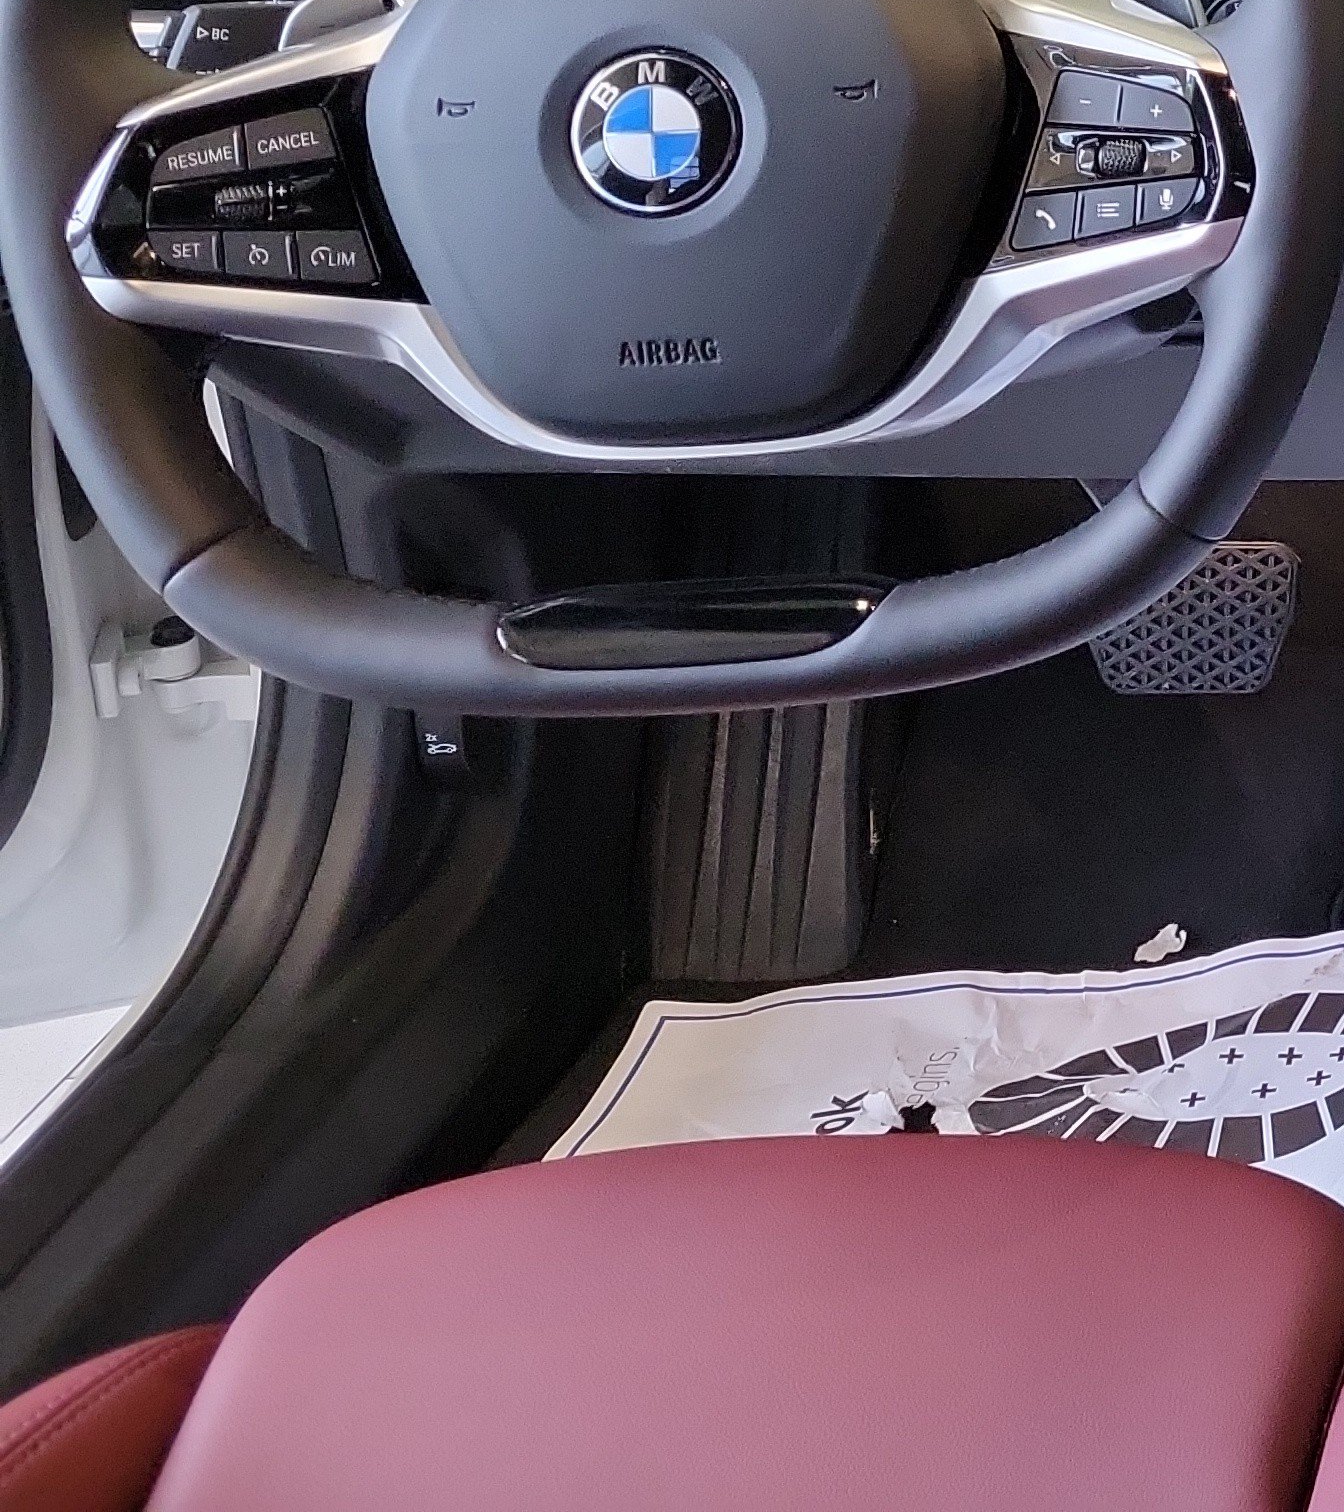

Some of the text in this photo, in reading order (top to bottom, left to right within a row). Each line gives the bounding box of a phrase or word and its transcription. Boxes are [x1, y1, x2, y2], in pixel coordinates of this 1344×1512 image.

[592, 60, 720, 112] BMW
[257, 131, 319, 155] CANCEL
[167, 145, 234, 172] RESUME
[172, 243, 200, 259] SET
[328, 251, 355, 268] LIM
[617, 338, 721, 368] AIRBAG
